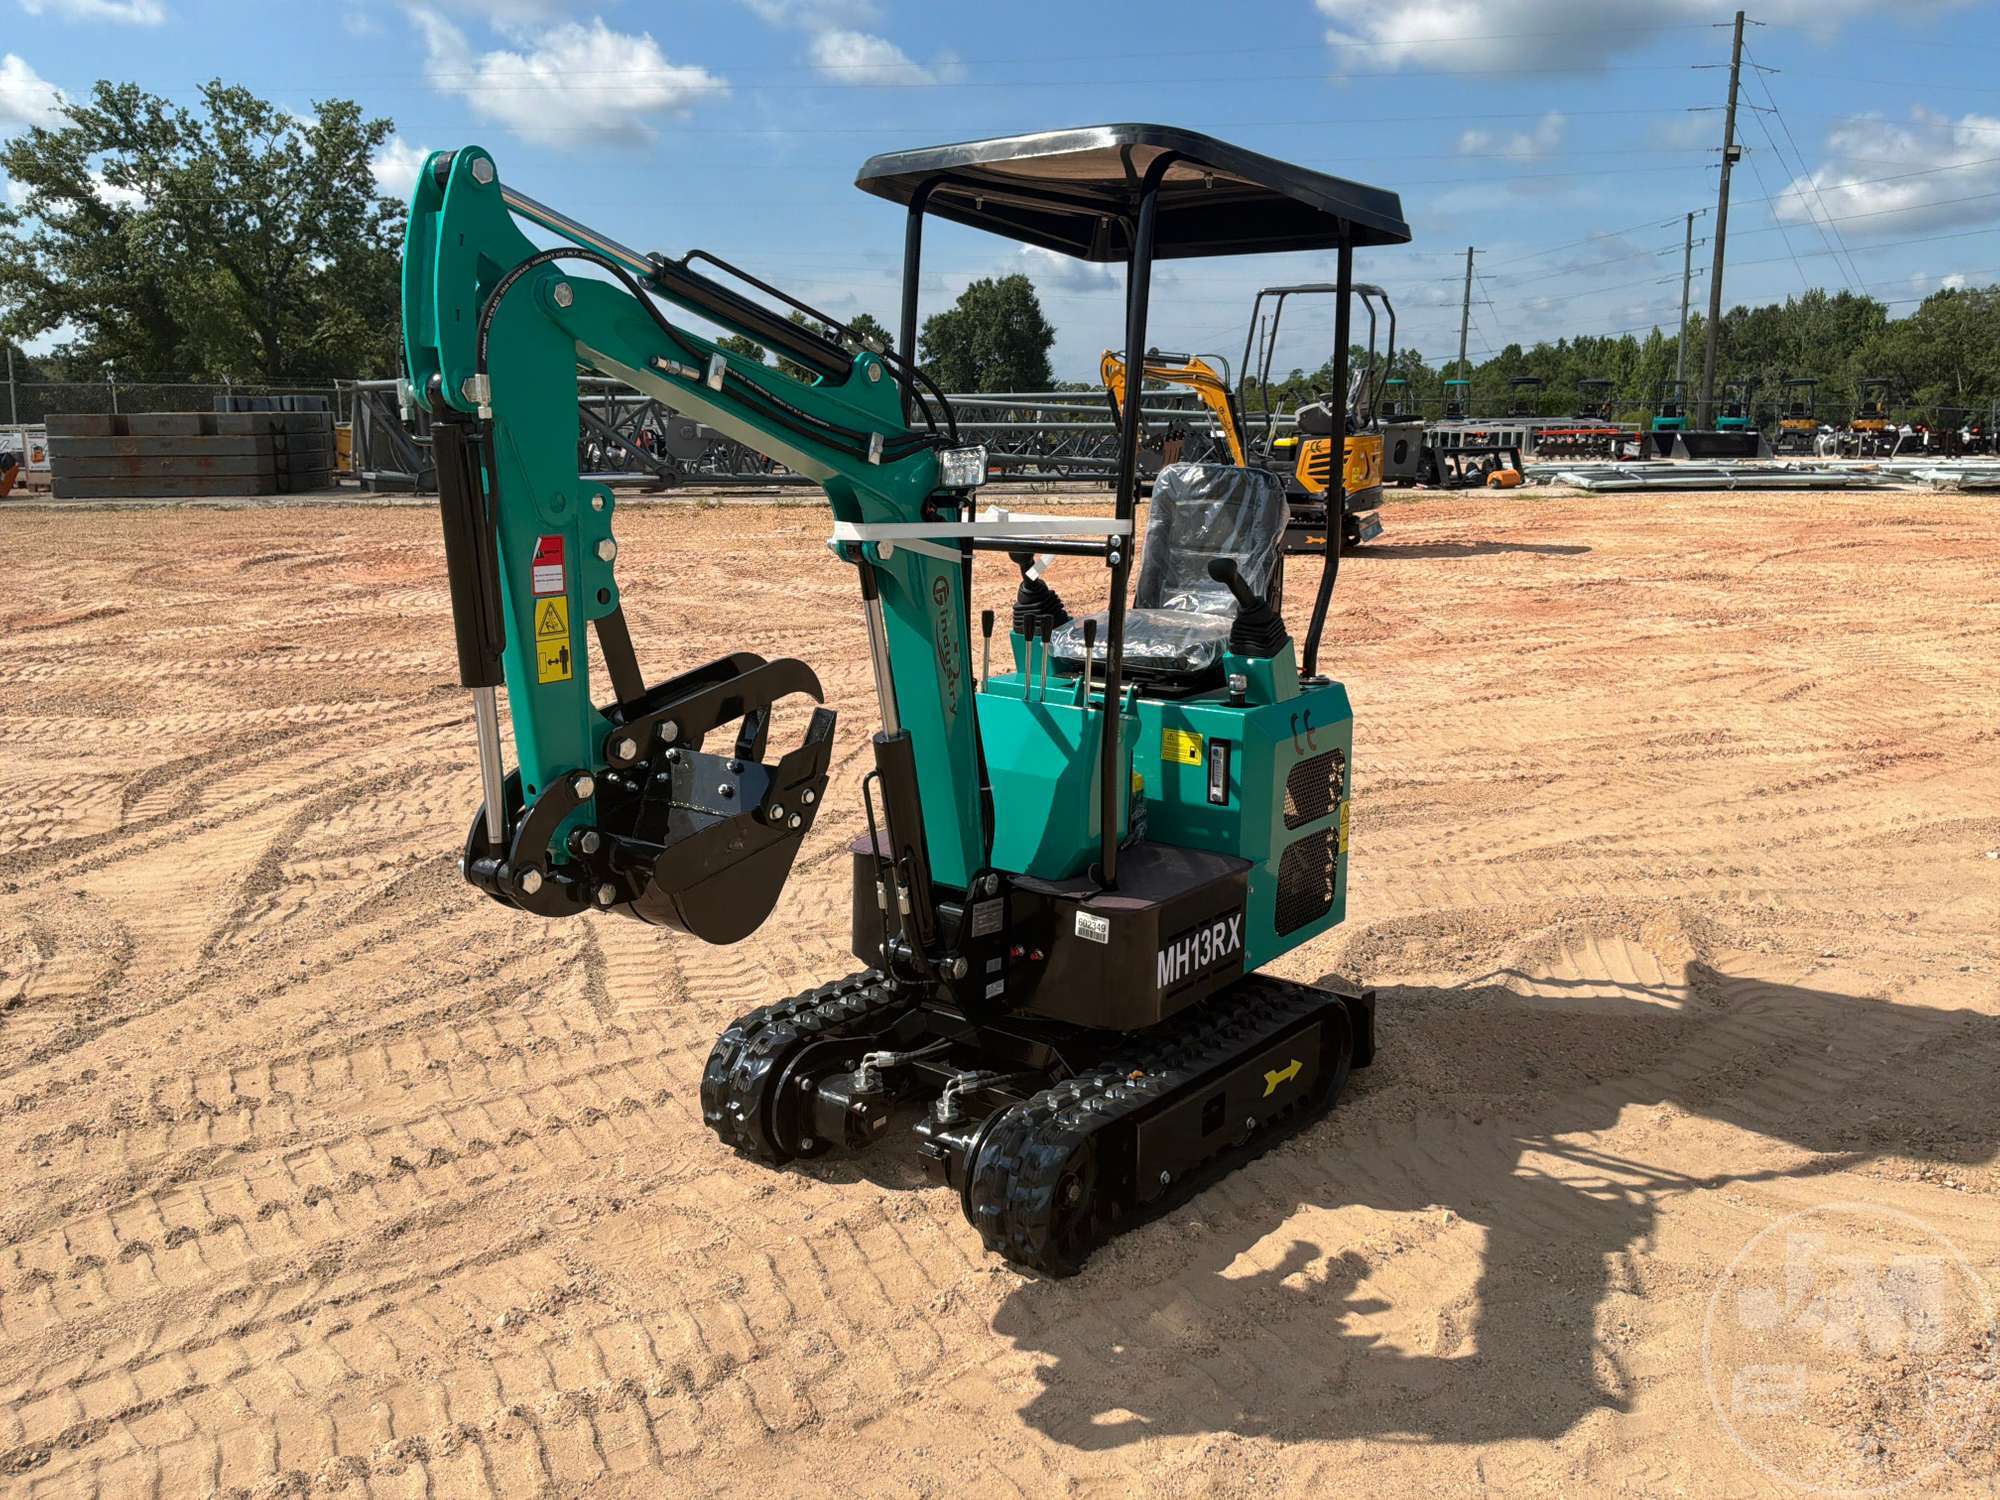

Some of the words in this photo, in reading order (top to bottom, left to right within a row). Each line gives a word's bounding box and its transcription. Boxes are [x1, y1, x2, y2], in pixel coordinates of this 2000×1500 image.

[1290, 708, 1317, 756] CE
[1077, 917, 1107, 933] 602349
[1156, 913, 1242, 990] MH13RX
